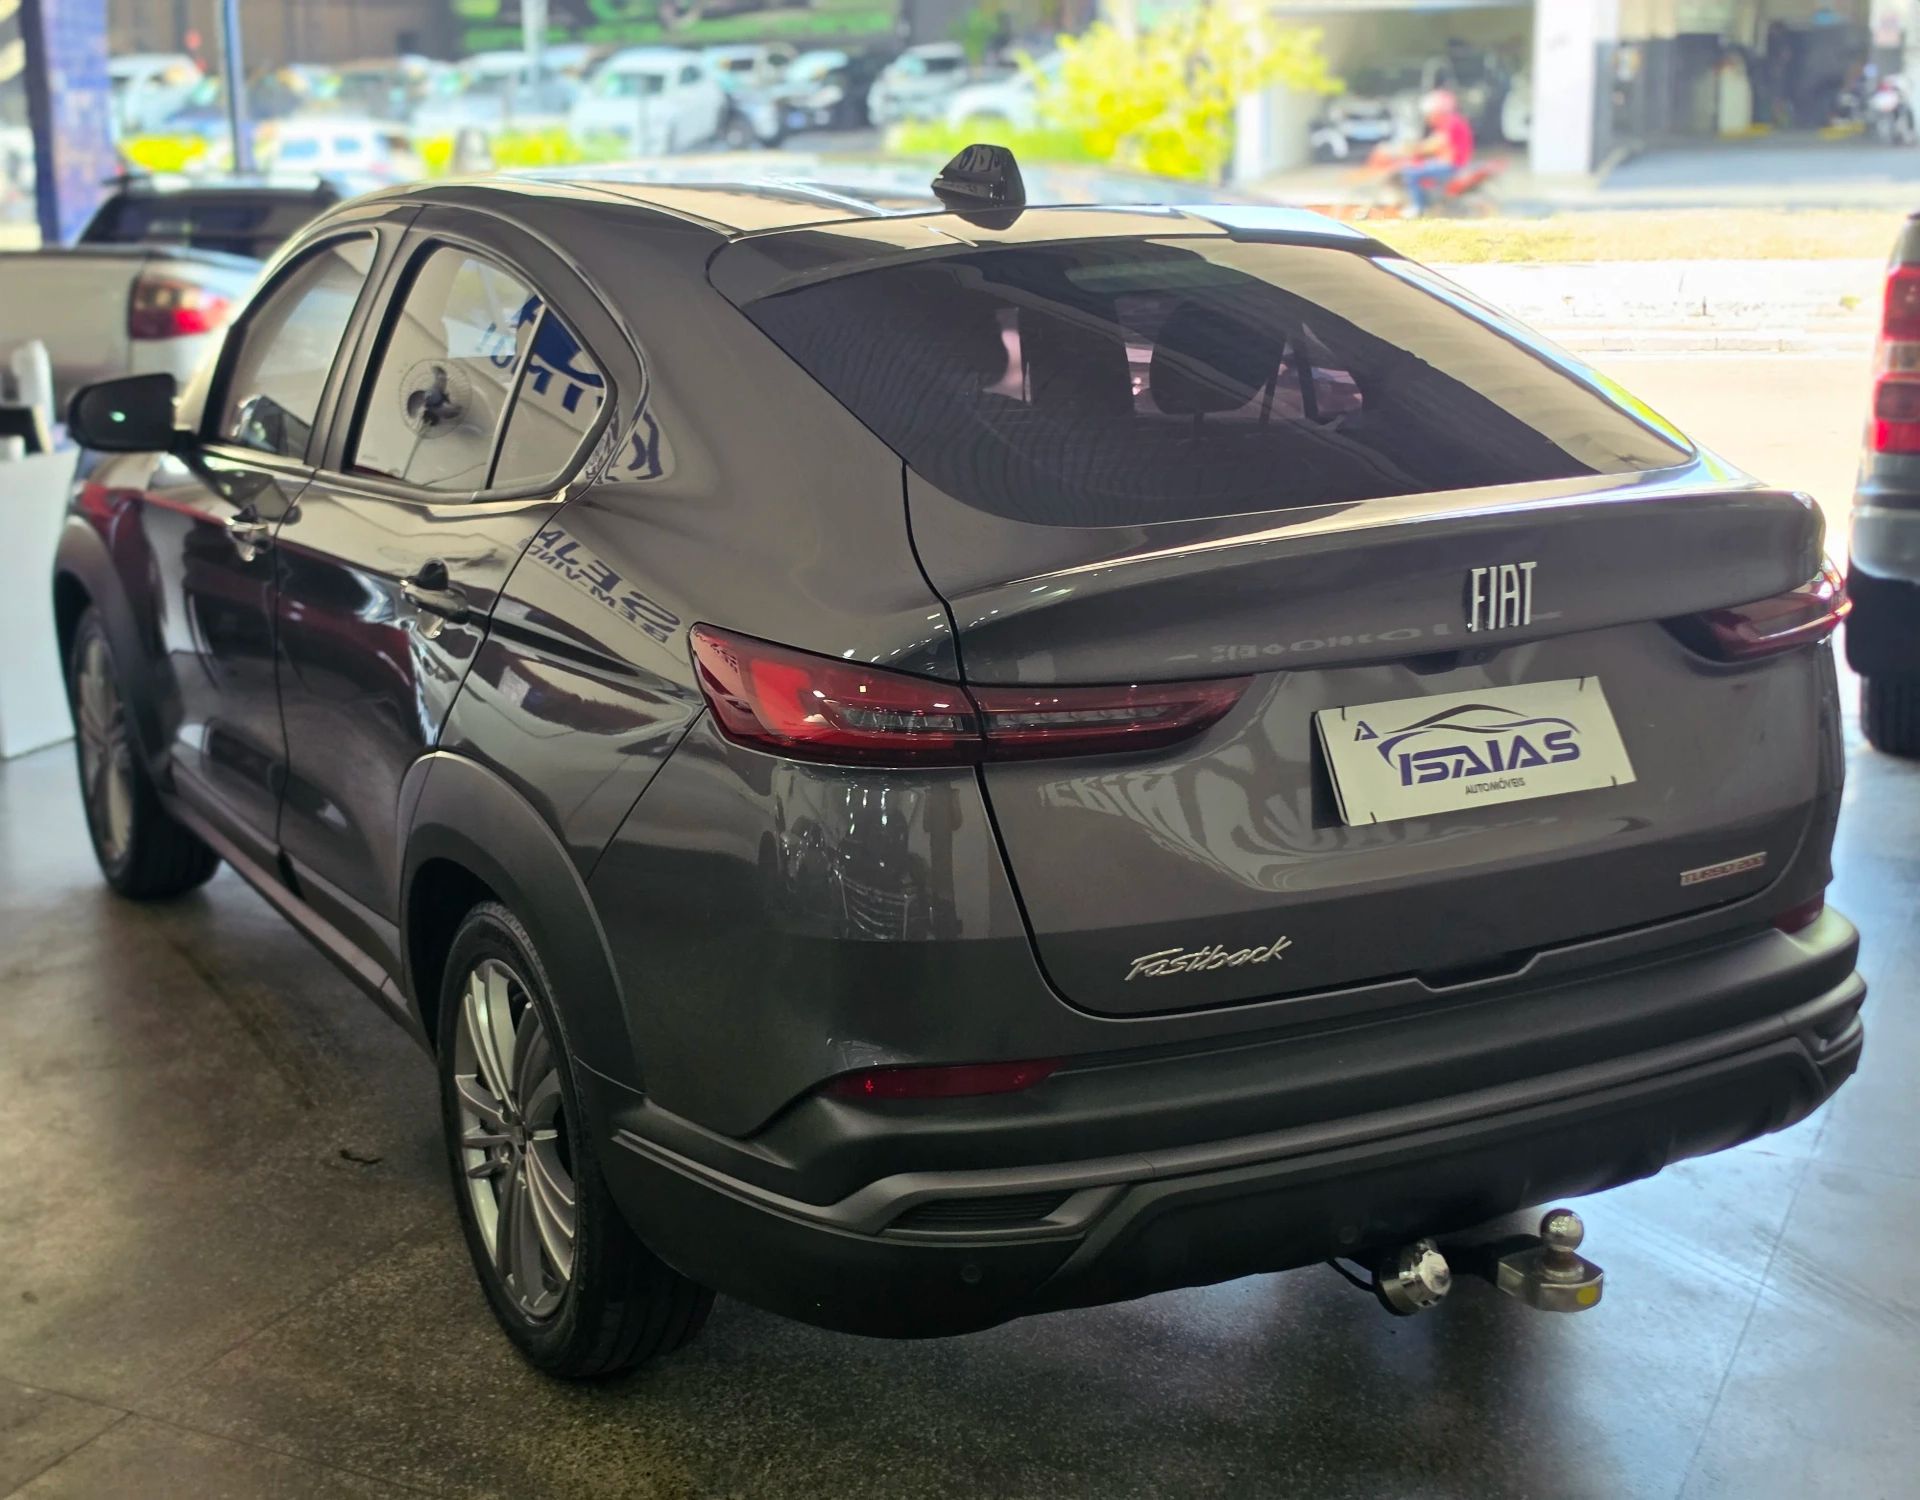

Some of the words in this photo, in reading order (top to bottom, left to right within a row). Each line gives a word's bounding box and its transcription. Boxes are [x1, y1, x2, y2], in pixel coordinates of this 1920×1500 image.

[1470, 561, 1537, 632] FIAT
[1397, 730, 1582, 786] ISAIAS
[1465, 777, 1526, 795] AUTOMÓVEIS
[1124, 935, 1292, 981] Fastback
